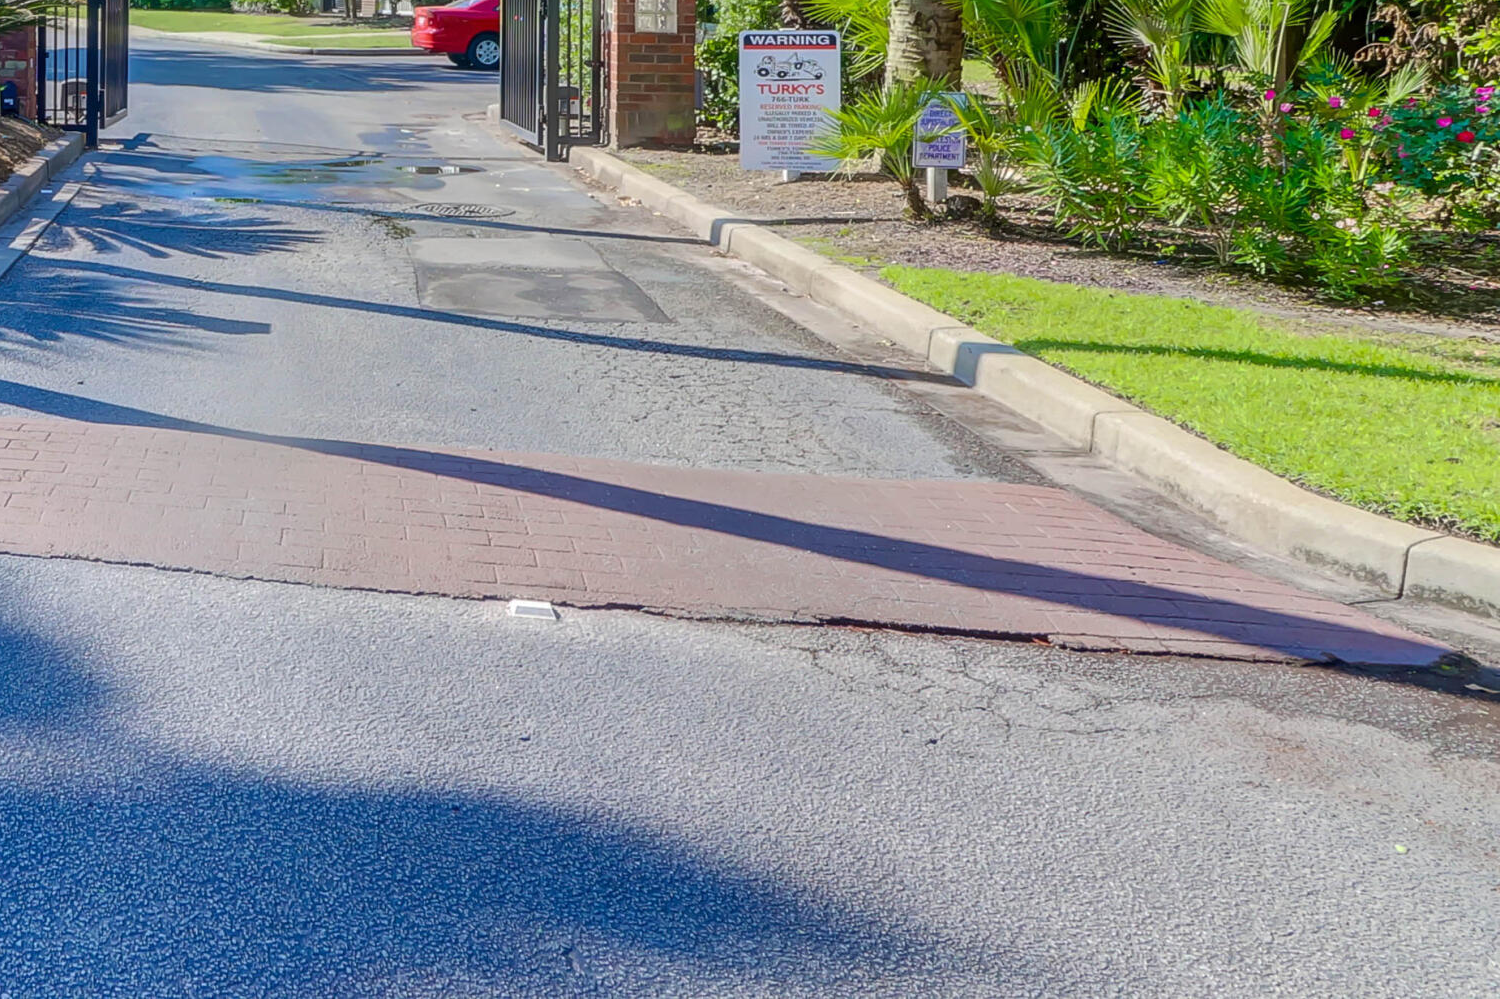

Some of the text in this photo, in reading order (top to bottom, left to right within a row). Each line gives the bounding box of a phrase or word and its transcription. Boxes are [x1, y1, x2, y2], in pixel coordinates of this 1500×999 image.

[750, 35, 830, 45] WARNING
[756, 83, 825, 95] TURKY'S
[928, 144, 952, 152] POLICE
